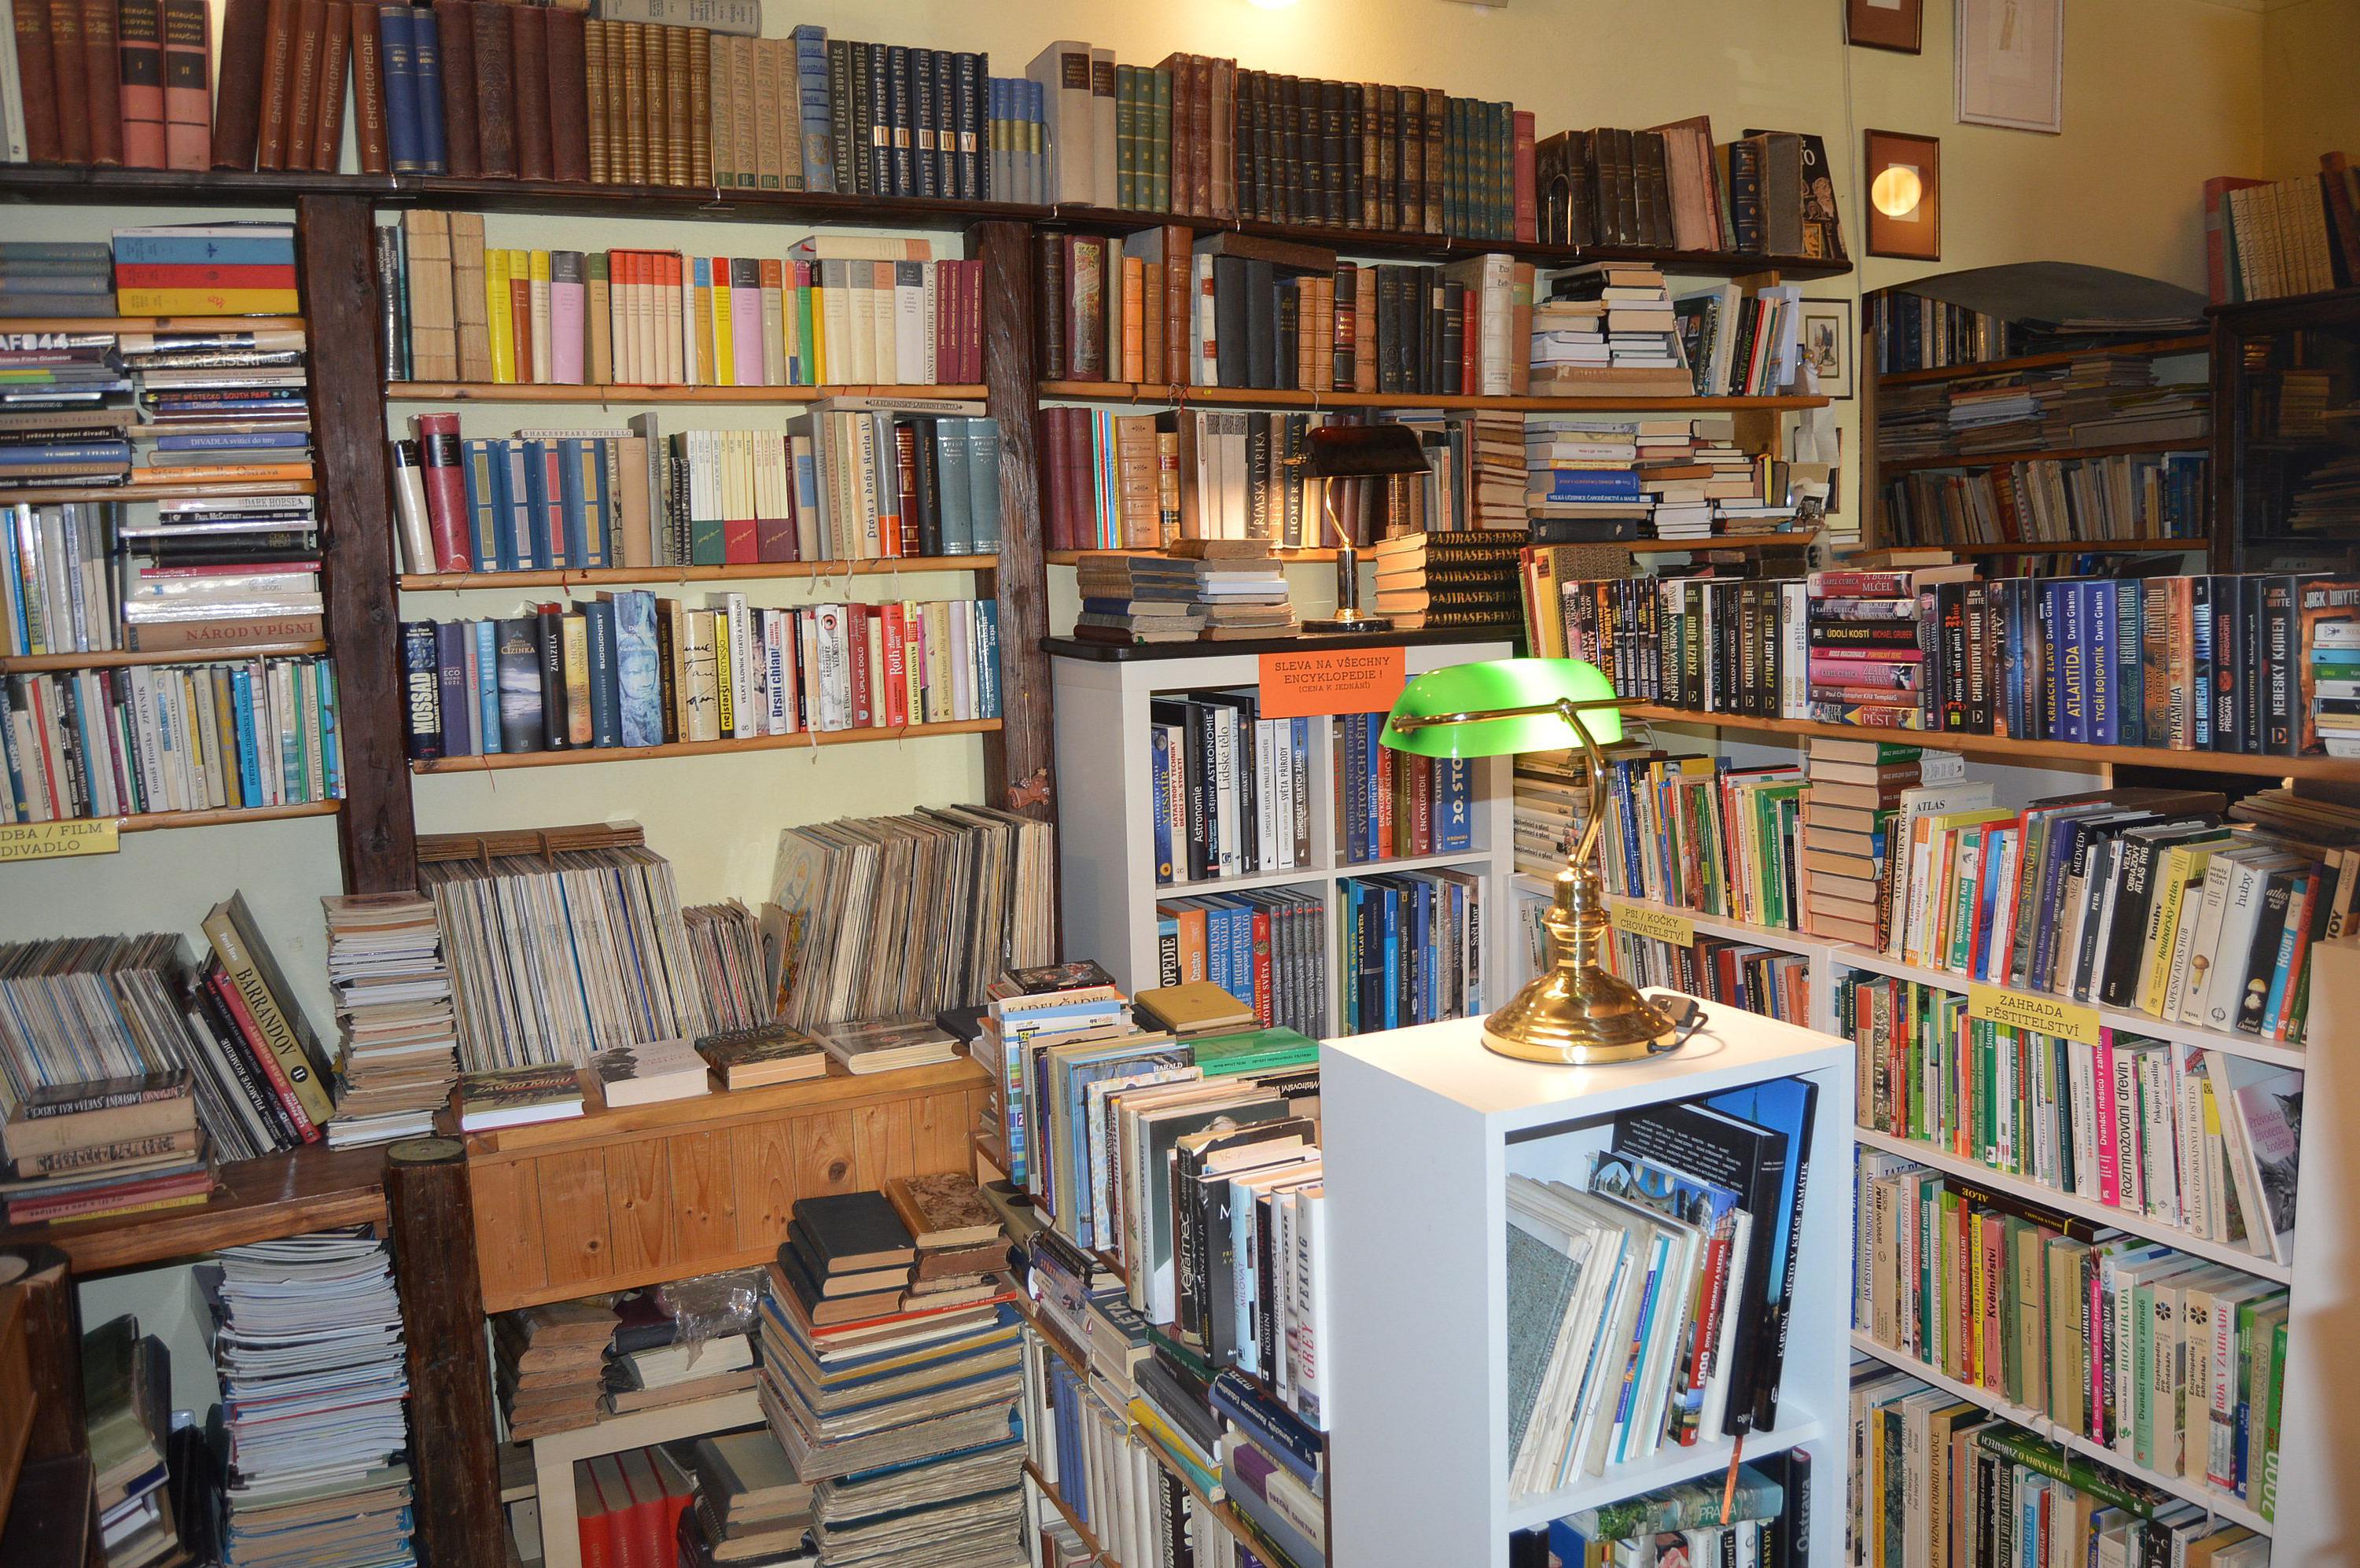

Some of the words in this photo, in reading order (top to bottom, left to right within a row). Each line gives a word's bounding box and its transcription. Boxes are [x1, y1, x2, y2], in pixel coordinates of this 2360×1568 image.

[1254, 431, 1265, 473] LYRIKA
[1291, 424, 1300, 482] ODSSEIA
[1289, 486, 1299, 535] HOMÉR
[1862, 581, 1892, 592] MLČEL
[2119, 586, 2135, 618] HROBKA
[2304, 591, 2325, 608] JACK
[2329, 589, 2359, 605] WHYTE
[186, 627, 251, 641] NÁROD
[267, 622, 315, 635] PÍSNI
[1744, 611, 1753, 629] CTI
[1827, 628, 1847, 639] ÚDOLÍ
[1849, 628, 1869, 639] KOSTÍ
[2148, 589, 2166, 644] ATLANTIDOU
[2194, 603, 2210, 660] ATLANTIDA
[548, 634, 559, 672] ZMIZELÁ
[2119, 620, 2137, 664] HERKULOVA
[889, 650, 903, 675] Roth
[1275, 660, 1313, 672] SLEVA
[1316, 659, 1333, 670] NA
[1335, 656, 1390, 669] VŠECHNY
[1744, 632, 1754, 688] KOROUHEV
[1283, 671, 1374, 685] ENCYKLOPEDIE
[2064, 646, 2081, 716] ATLANTIDA
[409, 672, 434, 734] MOSSAD
[770, 686, 782, 718] Drsní
[2093, 695, 2105, 722] TYGŘÍ
[2170, 687, 2182, 740] PYRAMIDA
[2196, 677, 2207, 719] DONEGAN
[1863, 712, 1890, 726] PĚST
[2196, 721, 2208, 743] GREG
[1206, 714, 1216, 782] ASTRONOMIE
[1217, 727, 1229, 749] tělo
[1219, 752, 1231, 791] Lidské
[1160, 770, 1171, 824] VESMÍR
[1207, 786, 1217, 812] DĚJINY
[1355, 755, 1368, 834] SVĚTOVÝCH
[1916, 799, 1946, 812] ATLAS
[61, 823, 103, 836] FILM
[1192, 786, 1204, 842] Astronomie
[1898, 803, 1908, 833] KOČEK
[1, 840, 80, 856] DIVADLO
[1897, 835, 1905, 871] PLEMEN
[2019, 838, 2037, 901] SERENGETI
[2235, 872, 2255, 907] huby
[1470, 907, 1478, 922] hor
[1621, 918, 1684, 942] CHOVATELSTVÍ
[1625, 909, 1638, 918] PSI
[1648, 912, 1679, 929] KOČKY
[2149, 902, 2163, 941] houby
[1470, 924, 1479, 947] Svět
[2179, 927, 2189, 945] HUB
[2277, 933, 2295, 969] HOUBY
[2174, 946, 2185, 972] ATLAS
[235, 966, 297, 1057] BARRANDOV
[1984, 1007, 2080, 1037] PĚSTITELSTVÍ
[2000, 995, 2064, 1018] ZAHRADA
[1153, 1062, 1183, 1072] HARALD
[1874, 1006, 1889, 1114] Skalničky
[2151, 1060, 2160, 1087] rostliny
[2115, 1062, 2130, 1101] dřevin
[2152, 1090, 2163, 1124] Pokojové
[2248, 1110, 2282, 1128] Průvodce
[2117, 1105, 2134, 1198] Rozmnožování
[2266, 1139, 2290, 1154] kotěte
[1795, 1161, 1809, 1211] PAMÁTEK
[1962, 1187, 1989, 1202] ALOE
[1921, 1198, 1931, 1228] rostliny
[1791, 1214, 1802, 1247] KRÁSE
[1298, 1236, 1311, 1313] PEKING
[1784, 1262, 1797, 1297] MĚSTO
[1986, 1247, 1997, 1318] Květinářství
[1104, 1301, 1146, 1330] LÉTA
[1696, 1351, 1710, 1386] 1000
[1703, 1331, 1712, 1348] DIVŮ
[1709, 1282, 1720, 1310] MORAVY
[1715, 1245, 1725, 1273] SLEZSKA
[2119, 1288, 2130, 1371] BIOZAHRADA
[2137, 1299, 2146, 1336] zahradě
[1301, 1321, 1316, 1379] GREY
[1776, 1311, 1789, 1356] KARVINÁ
[2137, 1346, 2146, 1380] měsíců
[2136, 1382, 2145, 1420] Dvanáct
[1796, 1478, 1810, 1552] Ostrava
